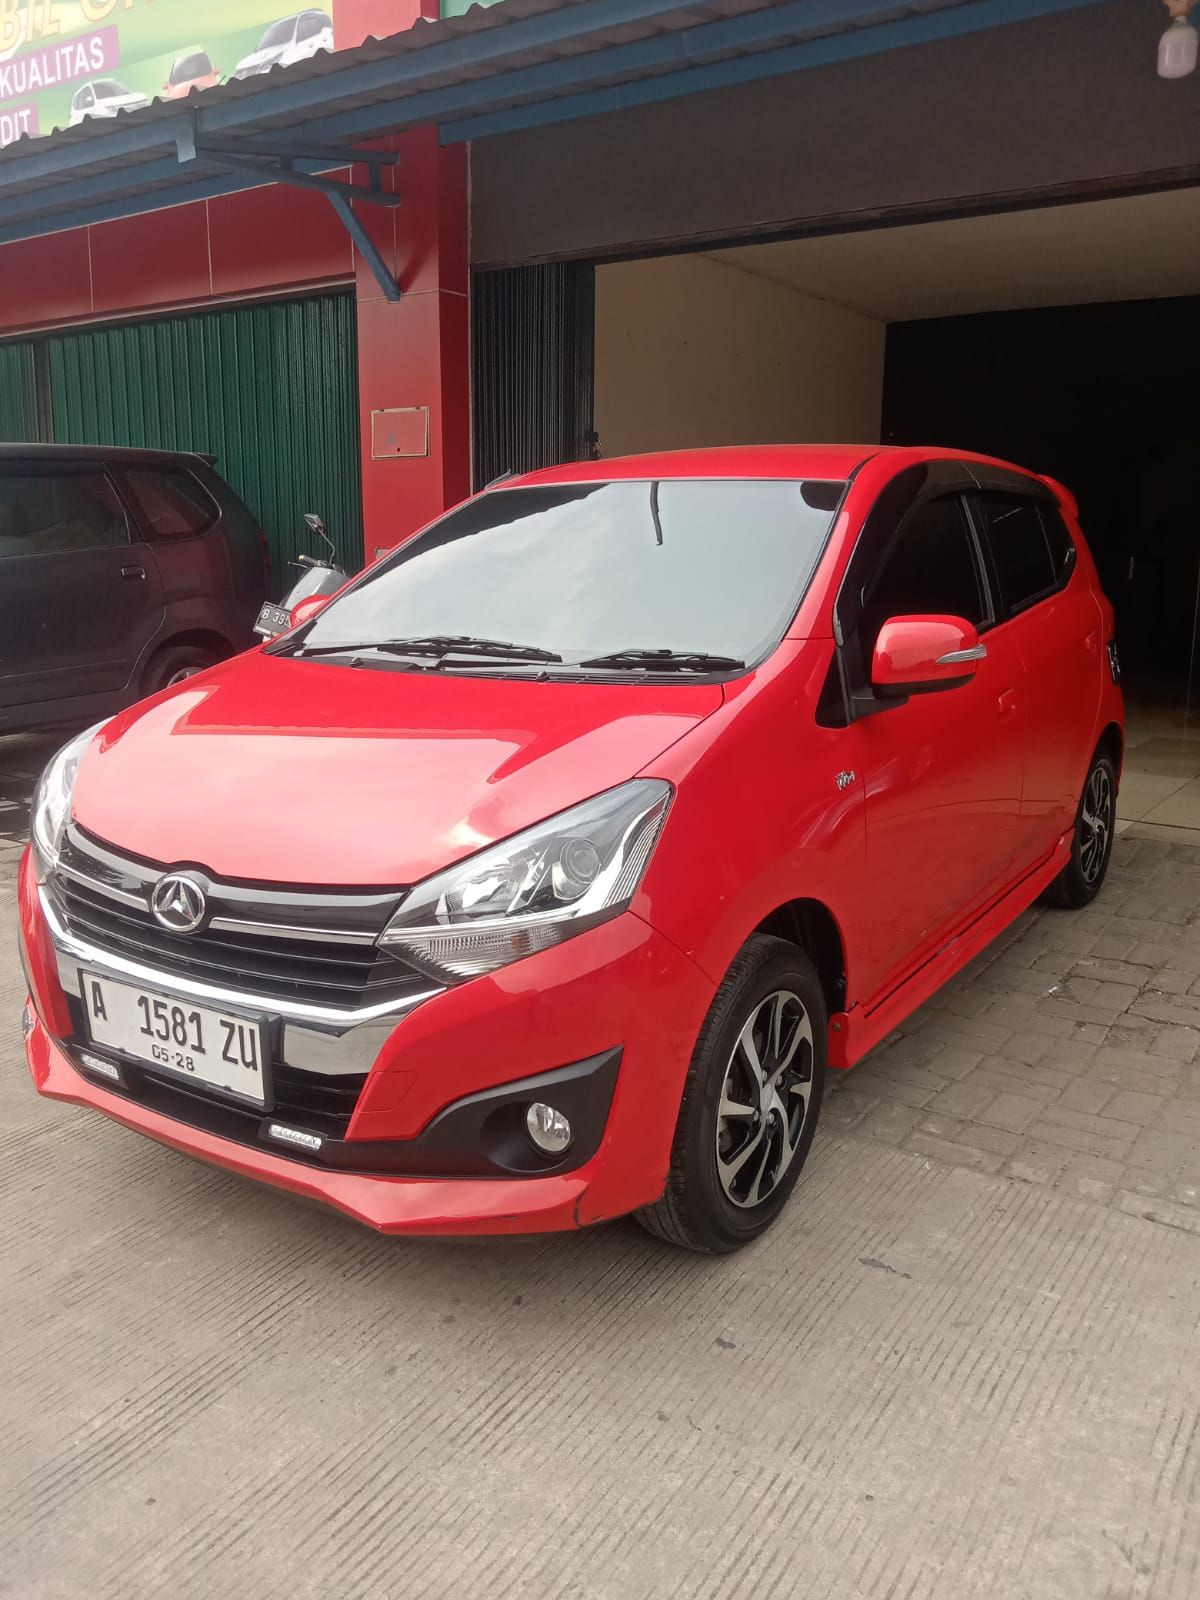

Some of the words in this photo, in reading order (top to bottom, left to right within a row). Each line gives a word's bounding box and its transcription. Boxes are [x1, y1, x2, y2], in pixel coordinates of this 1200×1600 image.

[0, 37, 104, 98] KUALITAS
[91, 981, 107, 1021] A
[138, 995, 206, 1054] 1581
[219, 1019, 258, 1071] ZU
